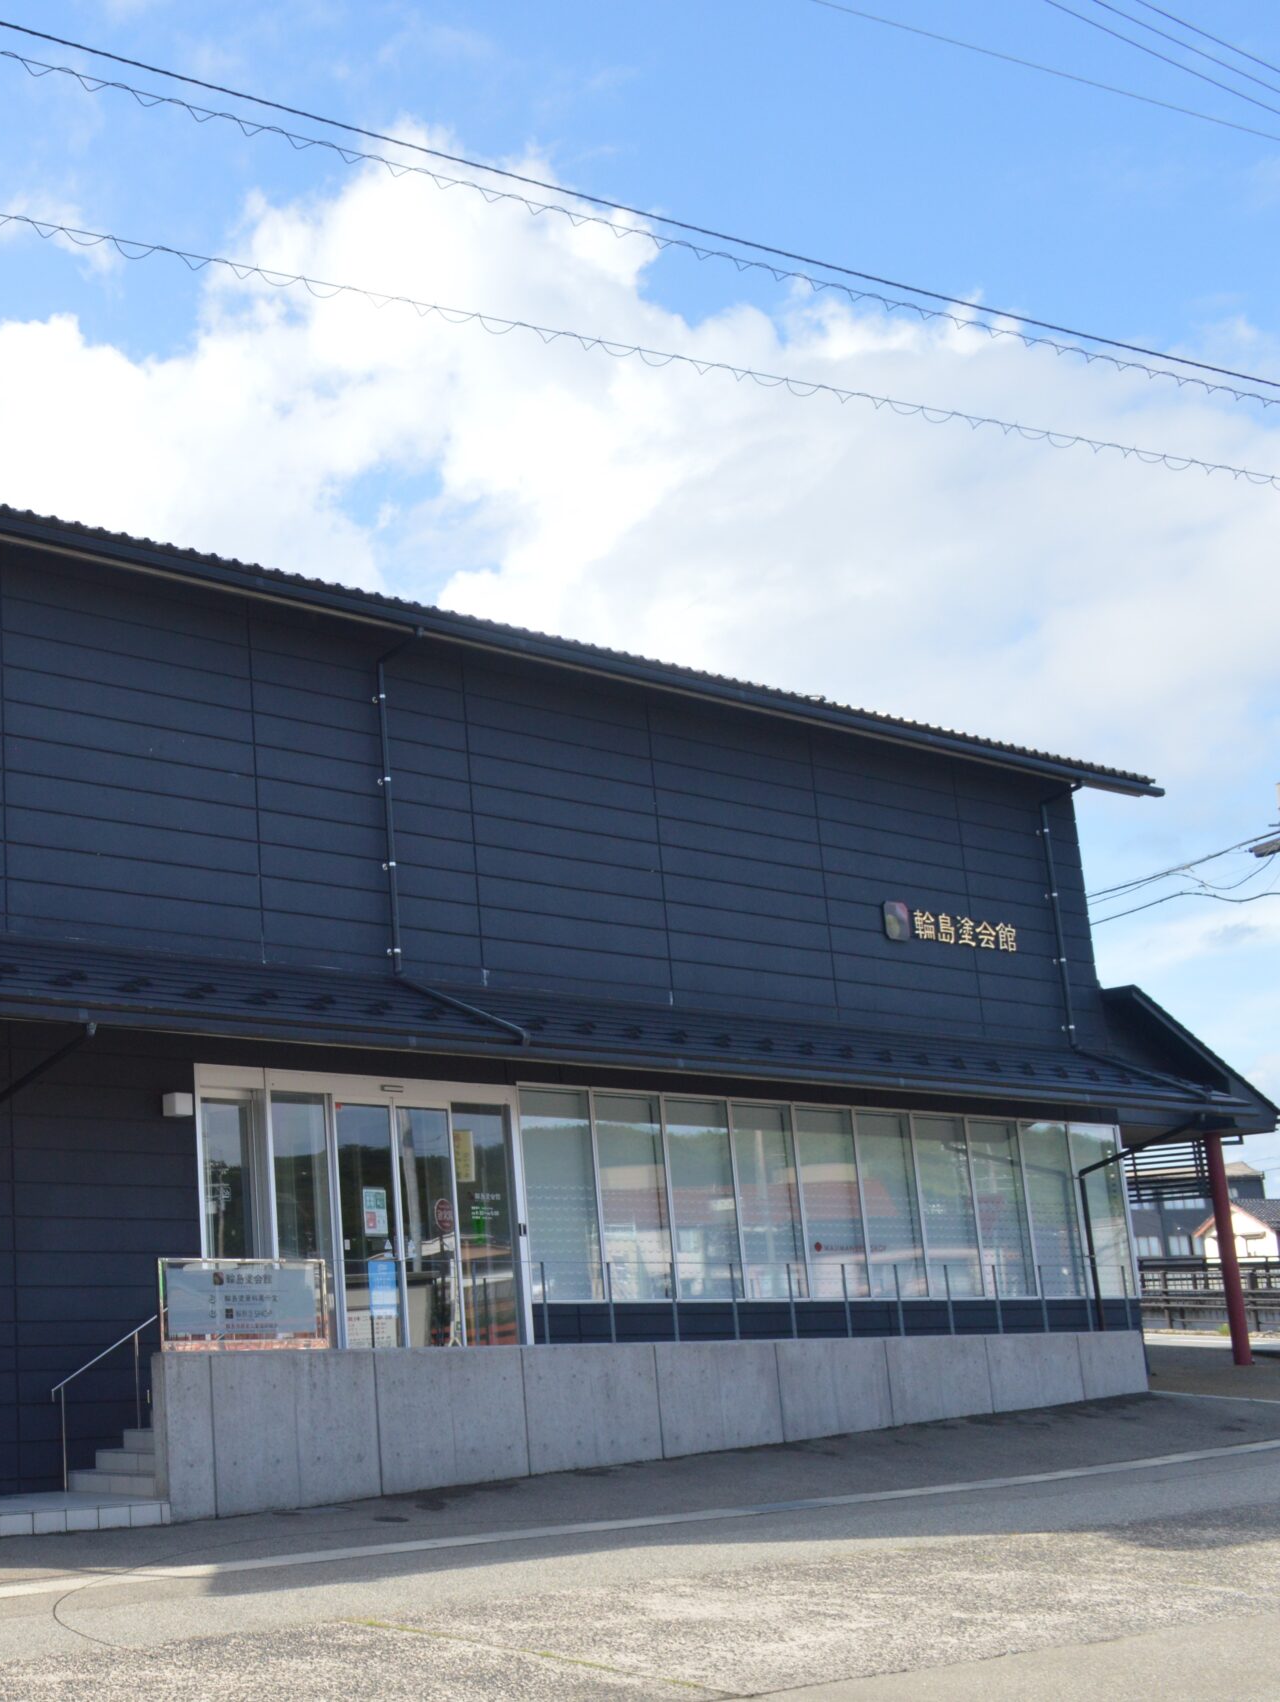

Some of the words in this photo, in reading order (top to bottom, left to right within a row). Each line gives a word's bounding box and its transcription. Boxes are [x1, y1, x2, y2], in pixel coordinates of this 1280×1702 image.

[913, 909, 1017, 952] 輪島塗会館
